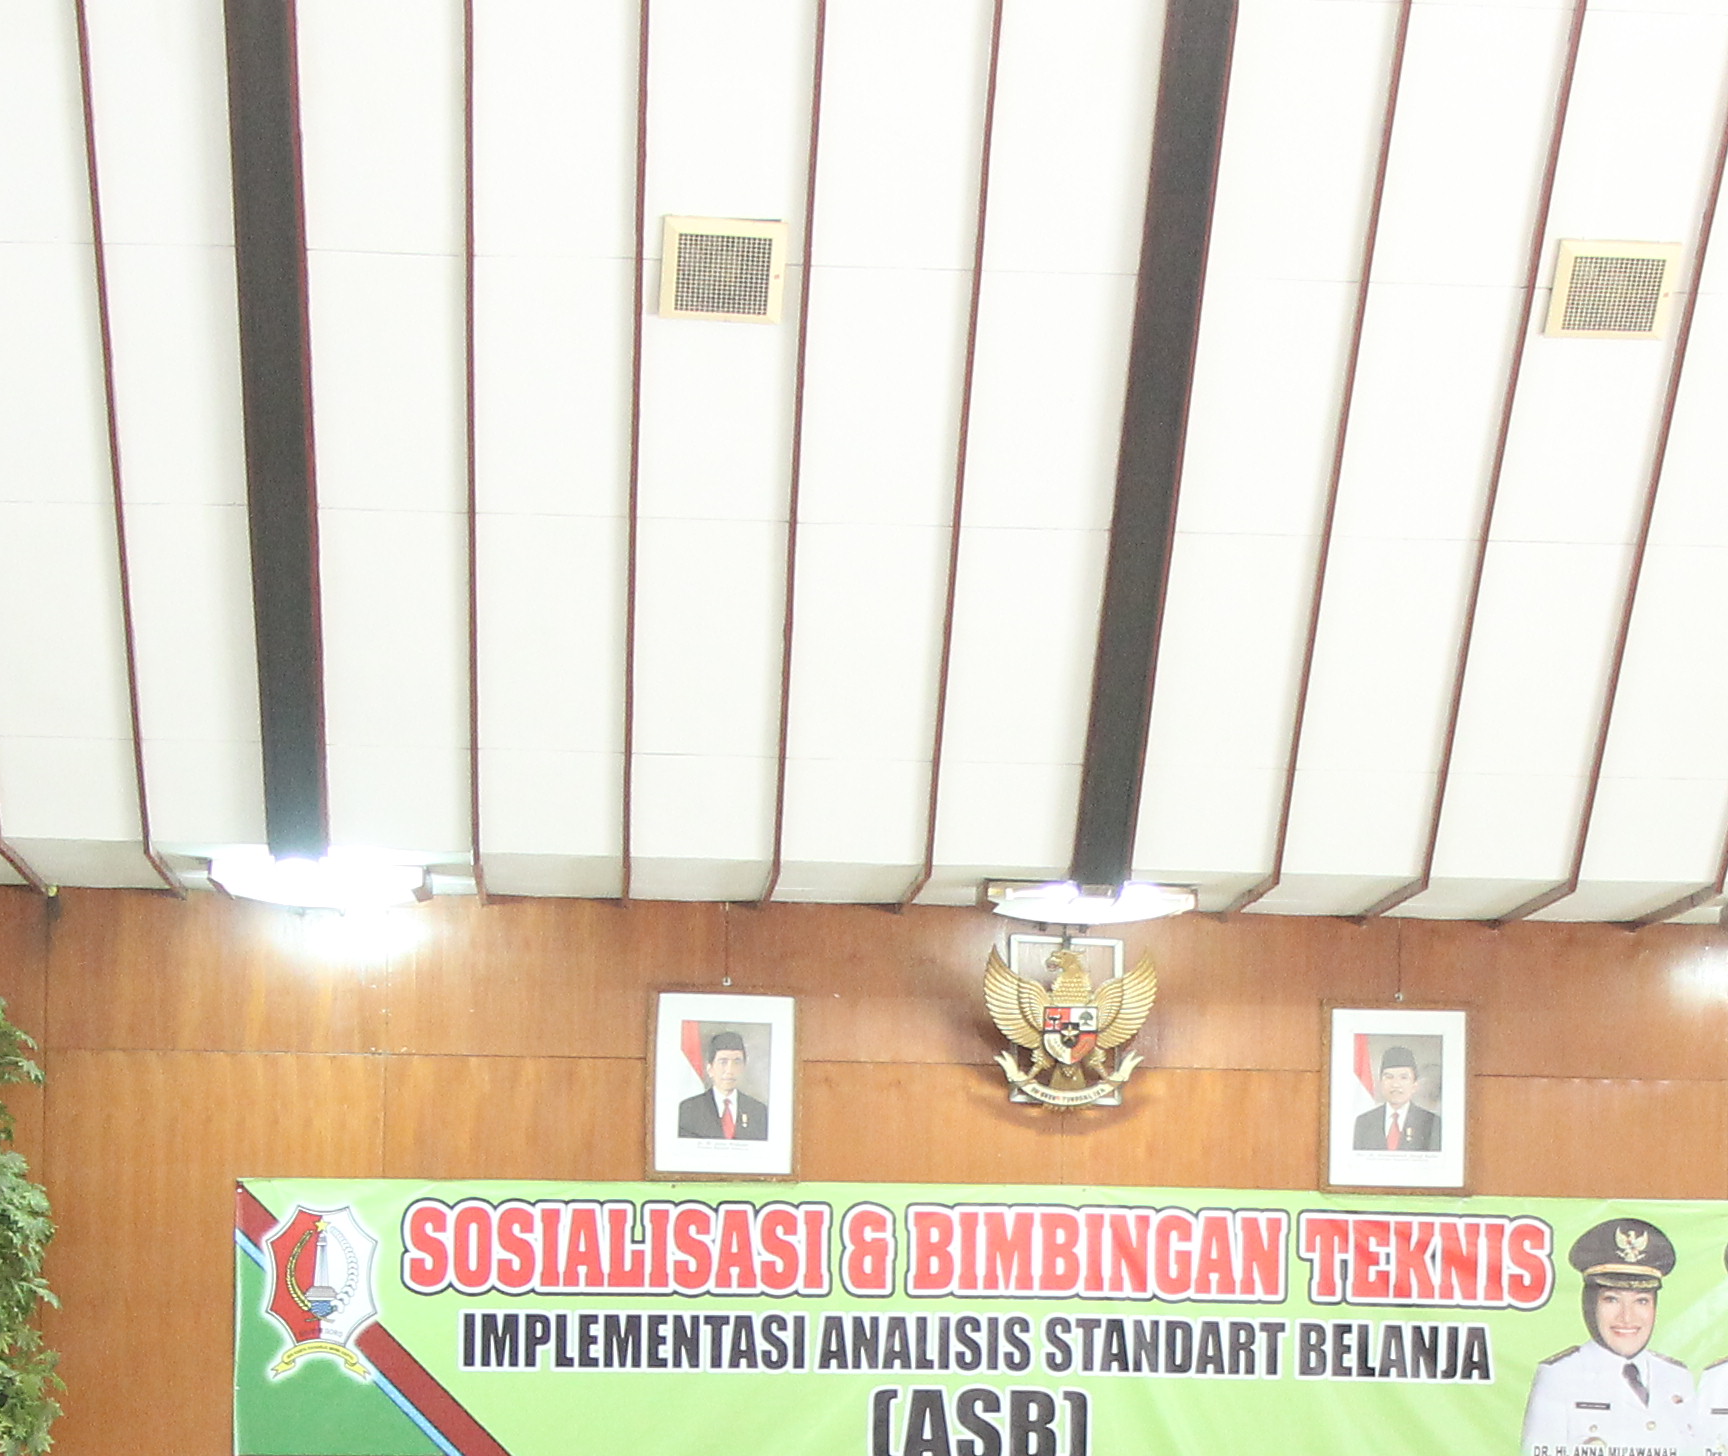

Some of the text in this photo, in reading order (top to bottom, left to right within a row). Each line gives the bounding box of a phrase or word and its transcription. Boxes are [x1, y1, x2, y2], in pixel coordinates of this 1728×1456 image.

[406, 1203, 1551, 1307] SOSIALISASI & BIMBINGAN TEKNIS
[462, 1312, 1492, 1381] IMPLEMENTASI ANALISIS STANDART BELANJA
